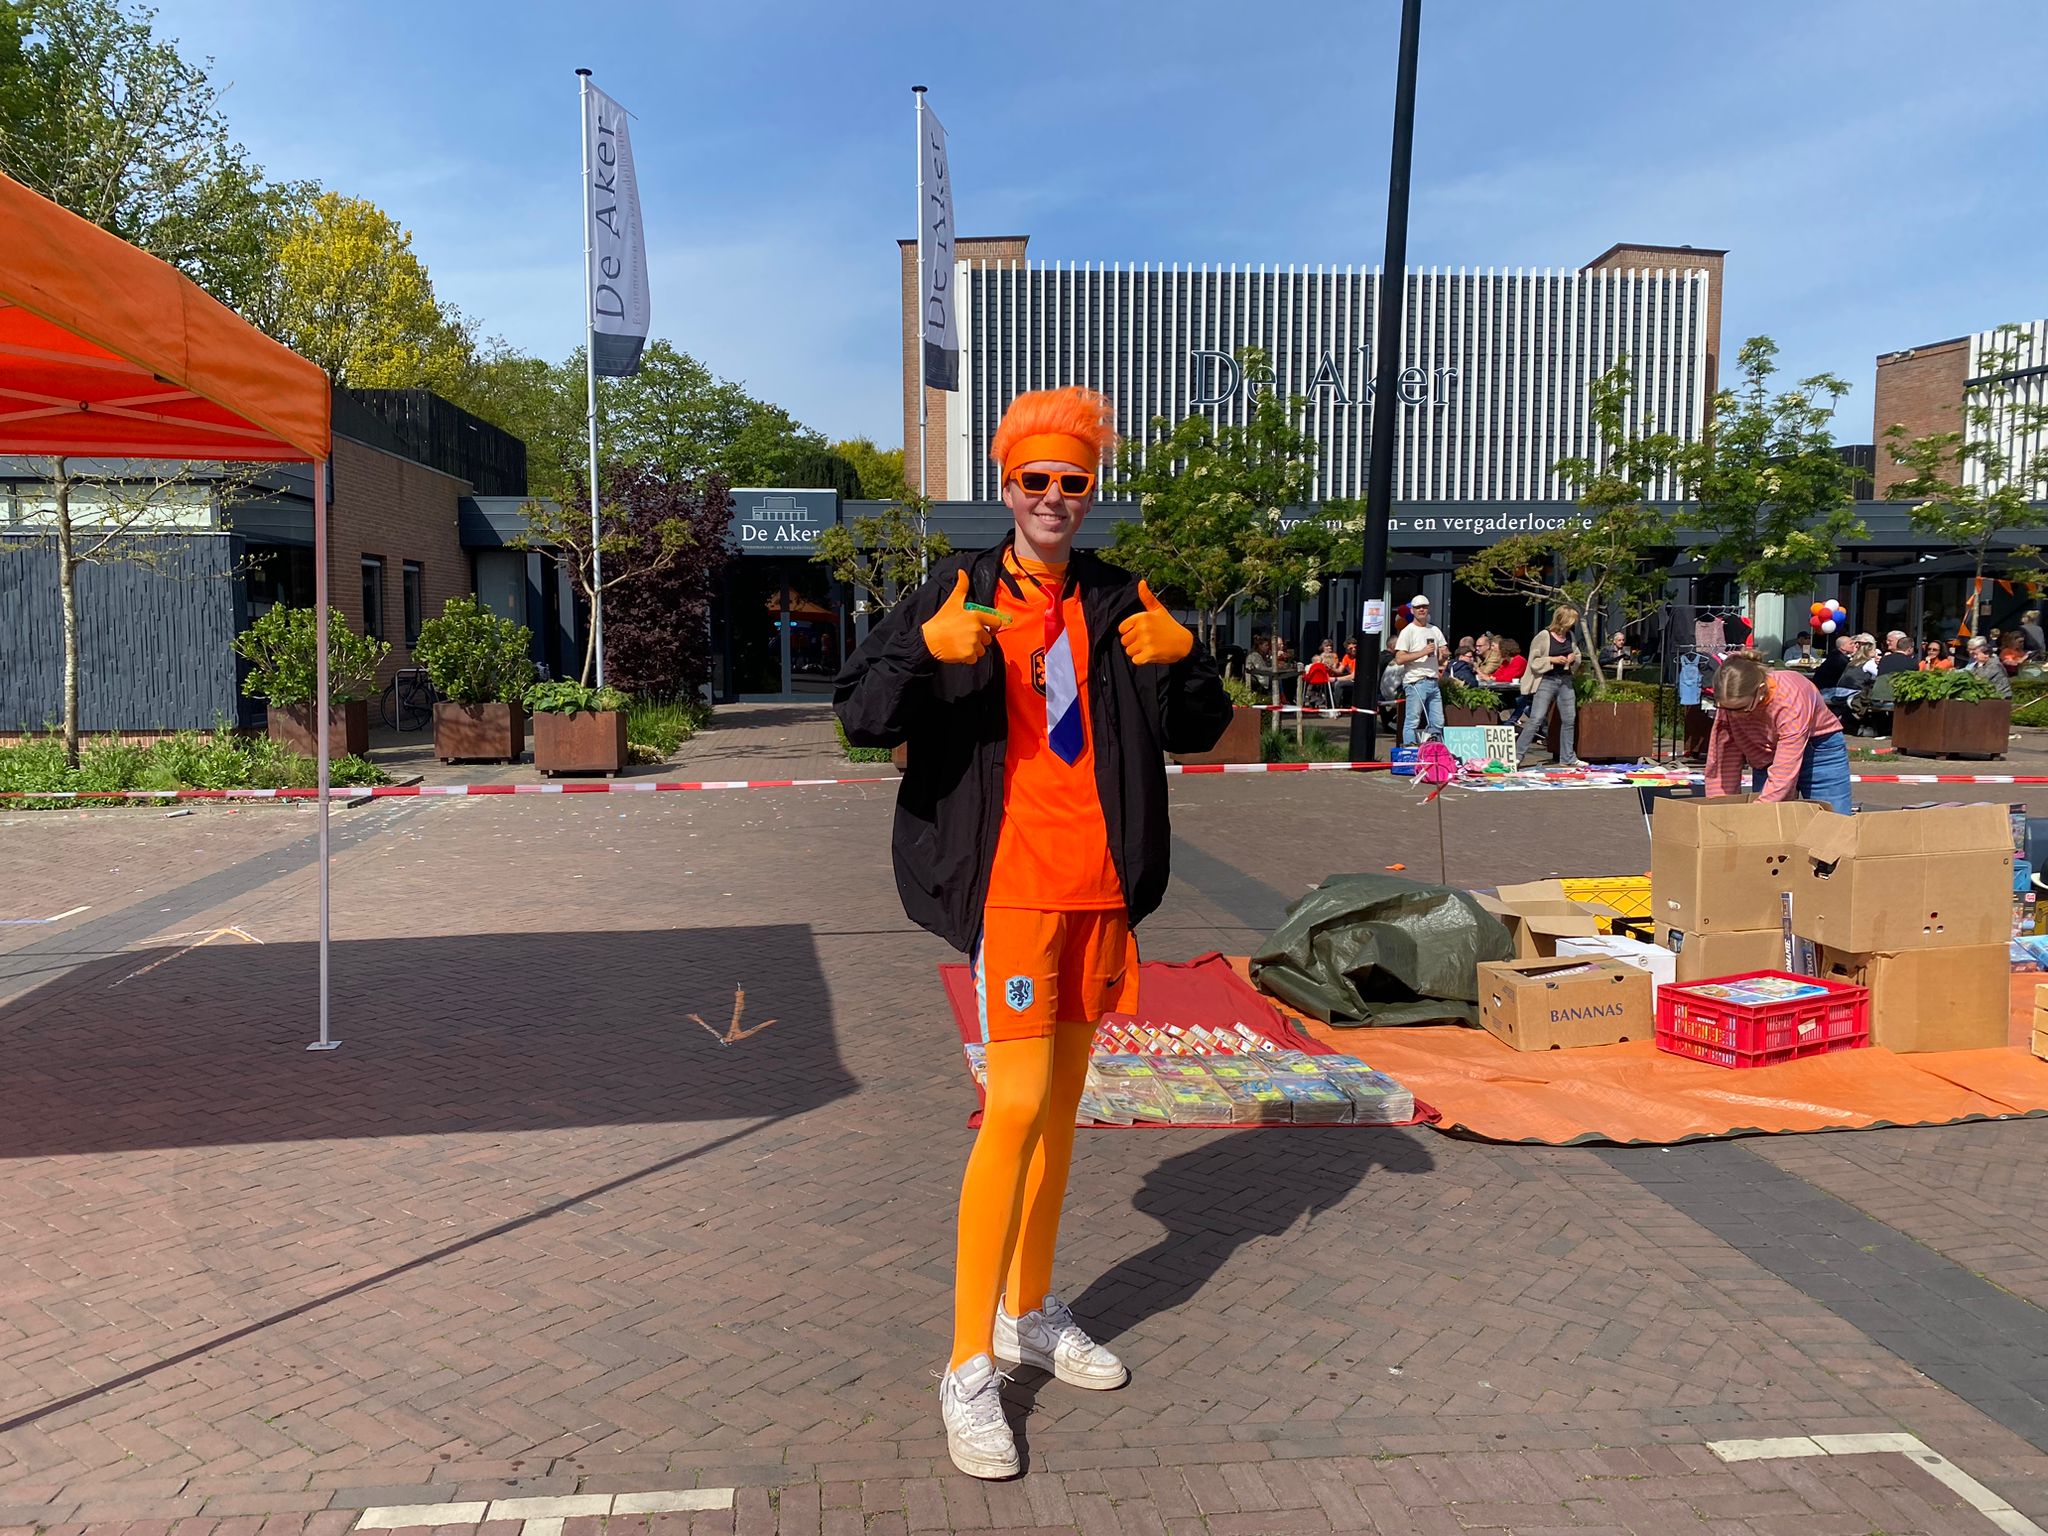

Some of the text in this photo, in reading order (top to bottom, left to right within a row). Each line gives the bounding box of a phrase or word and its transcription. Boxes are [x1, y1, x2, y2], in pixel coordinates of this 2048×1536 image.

[594, 115, 625, 321] De Aker
[1189, 350, 1278, 405] De
[741, 523, 820, 542] De Aker
[1413, 518, 1437, 530] en
[1486, 729, 1513, 742] EACE
[1488, 744, 1514, 763] OVE
[1550, 1002, 1624, 1023] BANANAS
